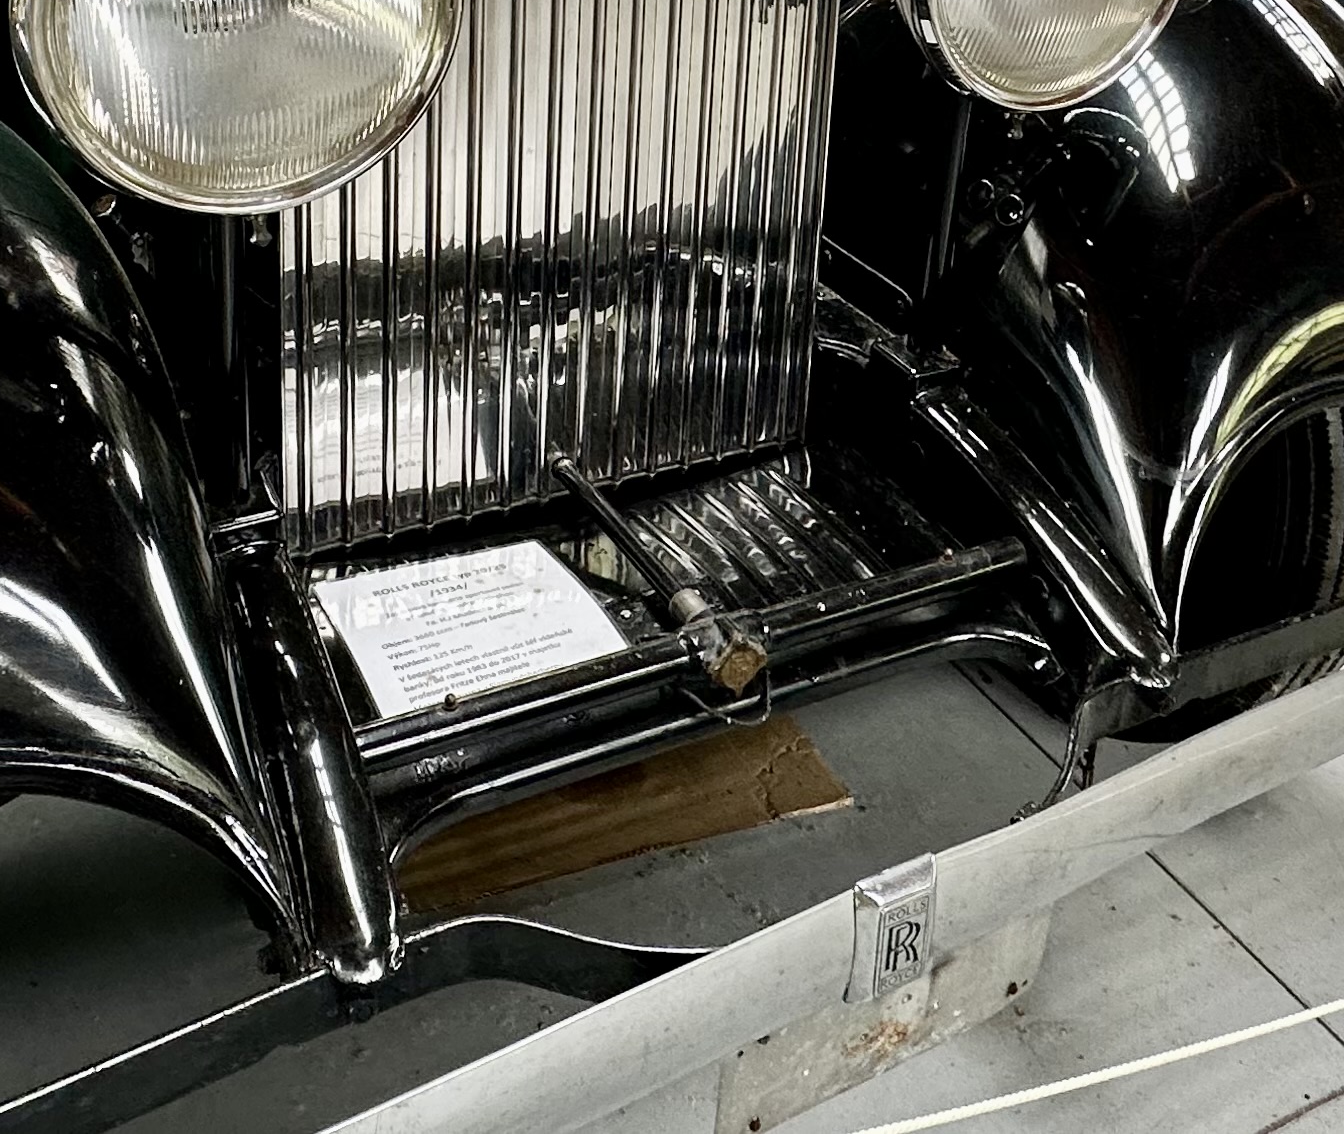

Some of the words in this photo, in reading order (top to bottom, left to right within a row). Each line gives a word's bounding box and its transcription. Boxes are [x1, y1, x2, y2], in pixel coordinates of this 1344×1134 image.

[371, 583, 410, 597] ROLLS
[410, 574, 450, 588] ROYCE
[888, 901, 926, 922] ROLLS
